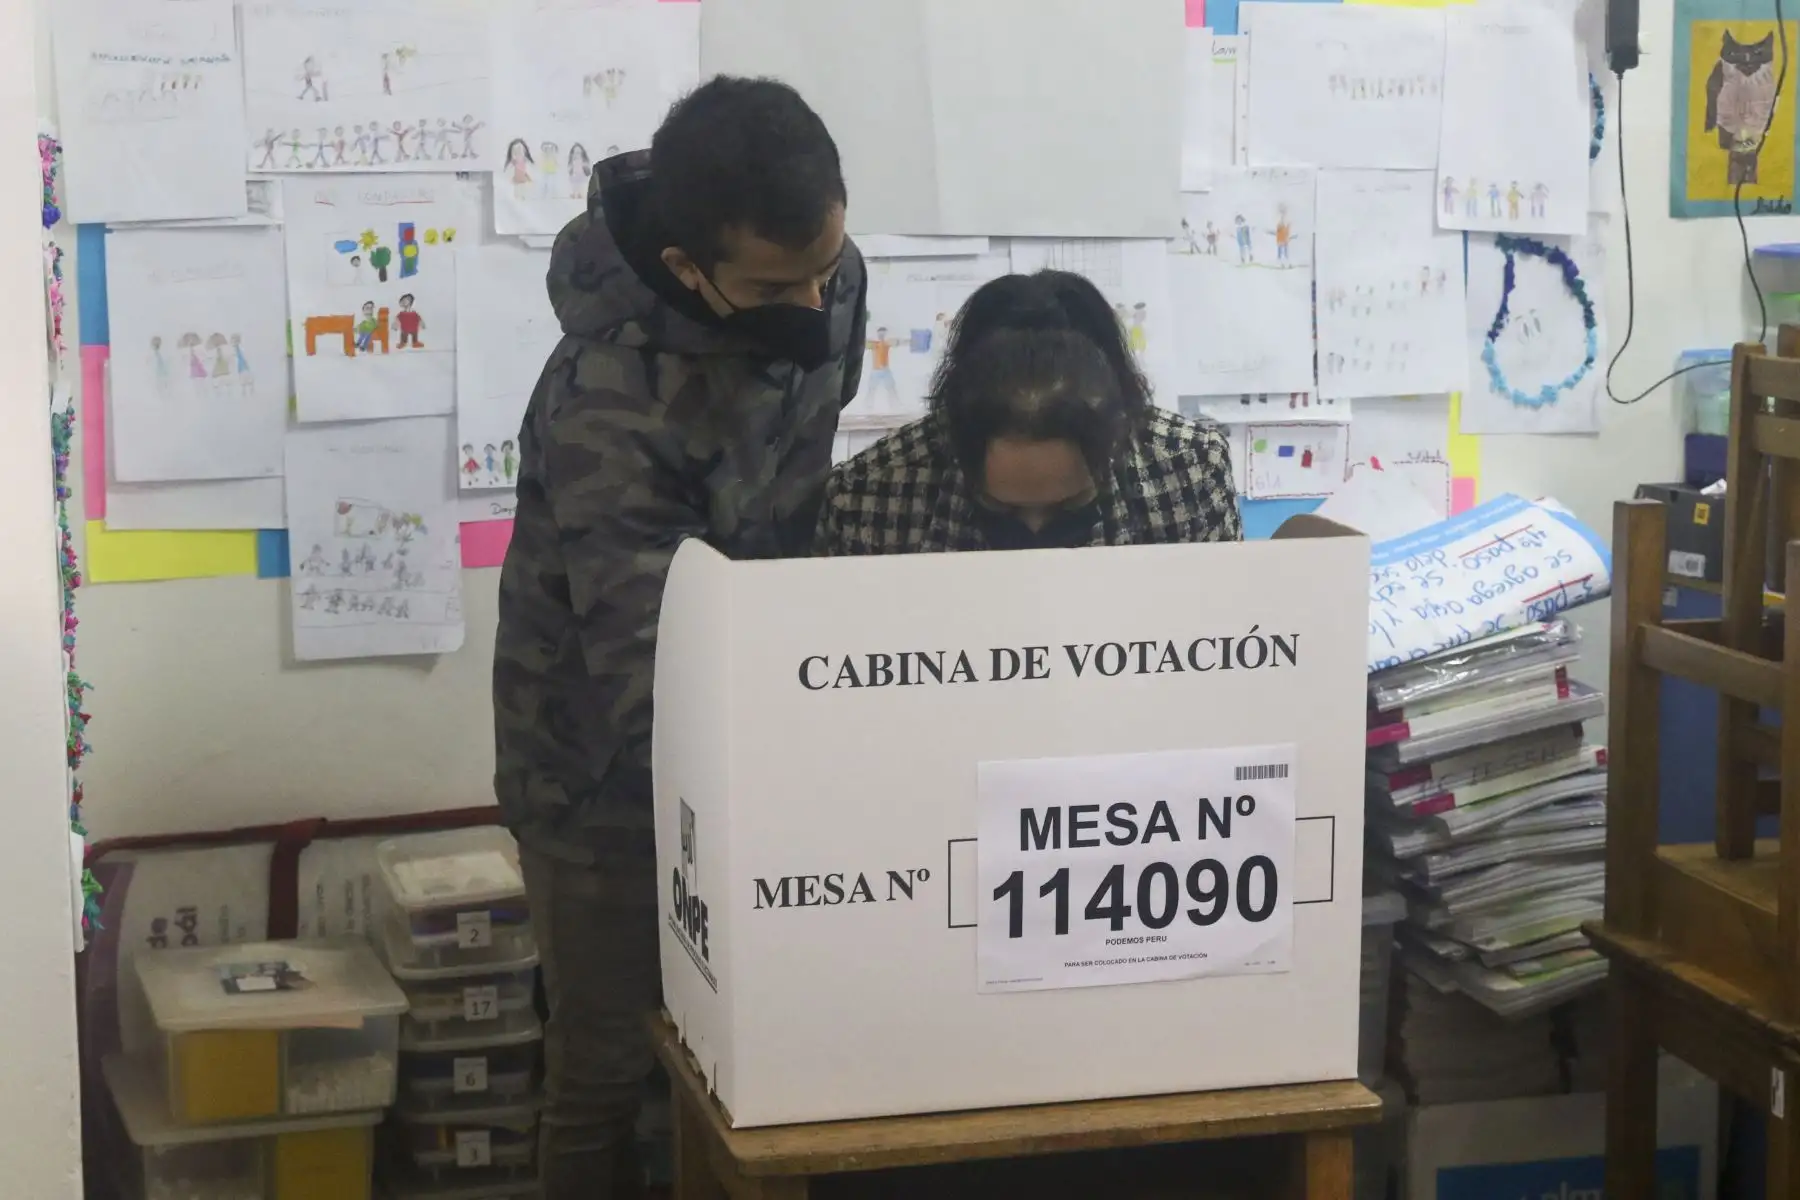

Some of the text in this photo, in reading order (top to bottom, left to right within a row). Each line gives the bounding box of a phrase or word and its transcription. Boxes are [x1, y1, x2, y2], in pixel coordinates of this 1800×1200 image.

[1466, 564, 1539, 606] agrega
[798, 624, 1300, 691] CABINA DE VOTACIÓN
[1020, 795, 1256, 851] MESA Nº
[753, 868, 931, 909] MESA Nº
[993, 855, 1278, 938] 114090
[672, 866, 710, 963] ONPE
[470, 928, 479, 943] 2
[1105, 935, 1168, 946] PODEMOS PERU
[1094, 958, 1128, 966] COLOCADO
[1147, 955, 1168, 963] CABINA
[1178, 952, 1208, 961] VOTACIÓN
[472, 1001, 491, 1018] 17
